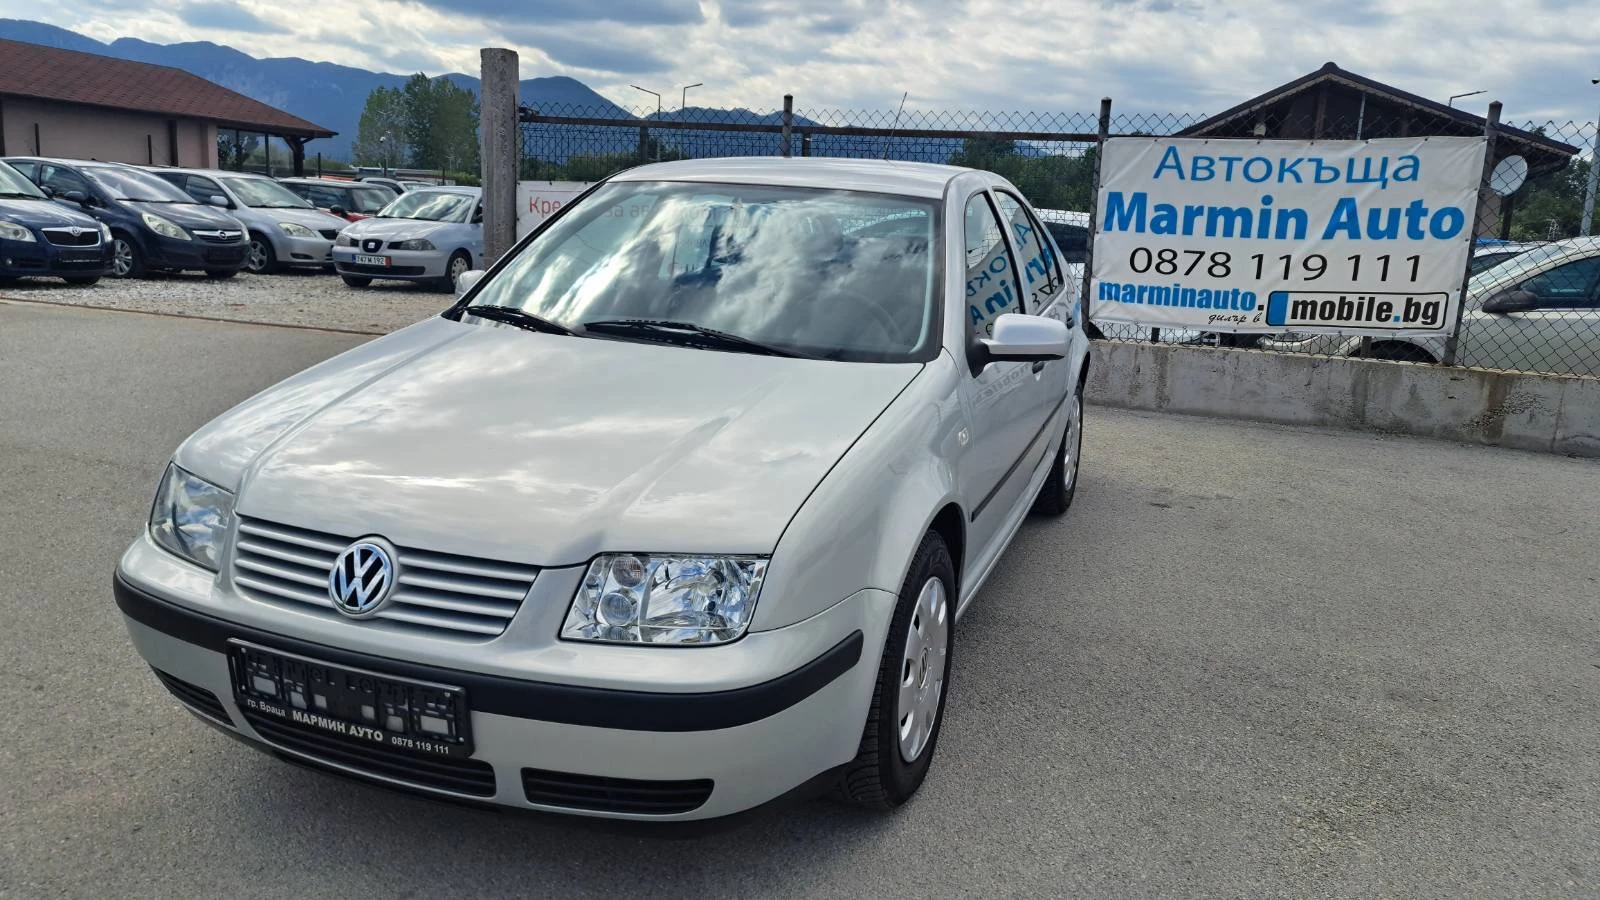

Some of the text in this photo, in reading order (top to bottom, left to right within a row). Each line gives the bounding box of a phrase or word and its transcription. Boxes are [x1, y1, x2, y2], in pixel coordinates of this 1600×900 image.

[1153, 145, 1421, 190] Автокъща
[529, 196, 562, 218] Кре
[1103, 191, 1466, 241] Marmin Auto
[1129, 247, 1421, 283] 0878 119 111
[1208, 313, 1248, 325] дилър
[1290, 295, 1441, 327] mobile.bg
[259, 701, 286, 717] Враца
[292, 710, 346, 733] МАРМИН
[349, 725, 384, 742] АУТО
[391, 736, 414, 748] 0878
[416, 741, 432, 751] 119
[434, 744, 449, 754] 111
